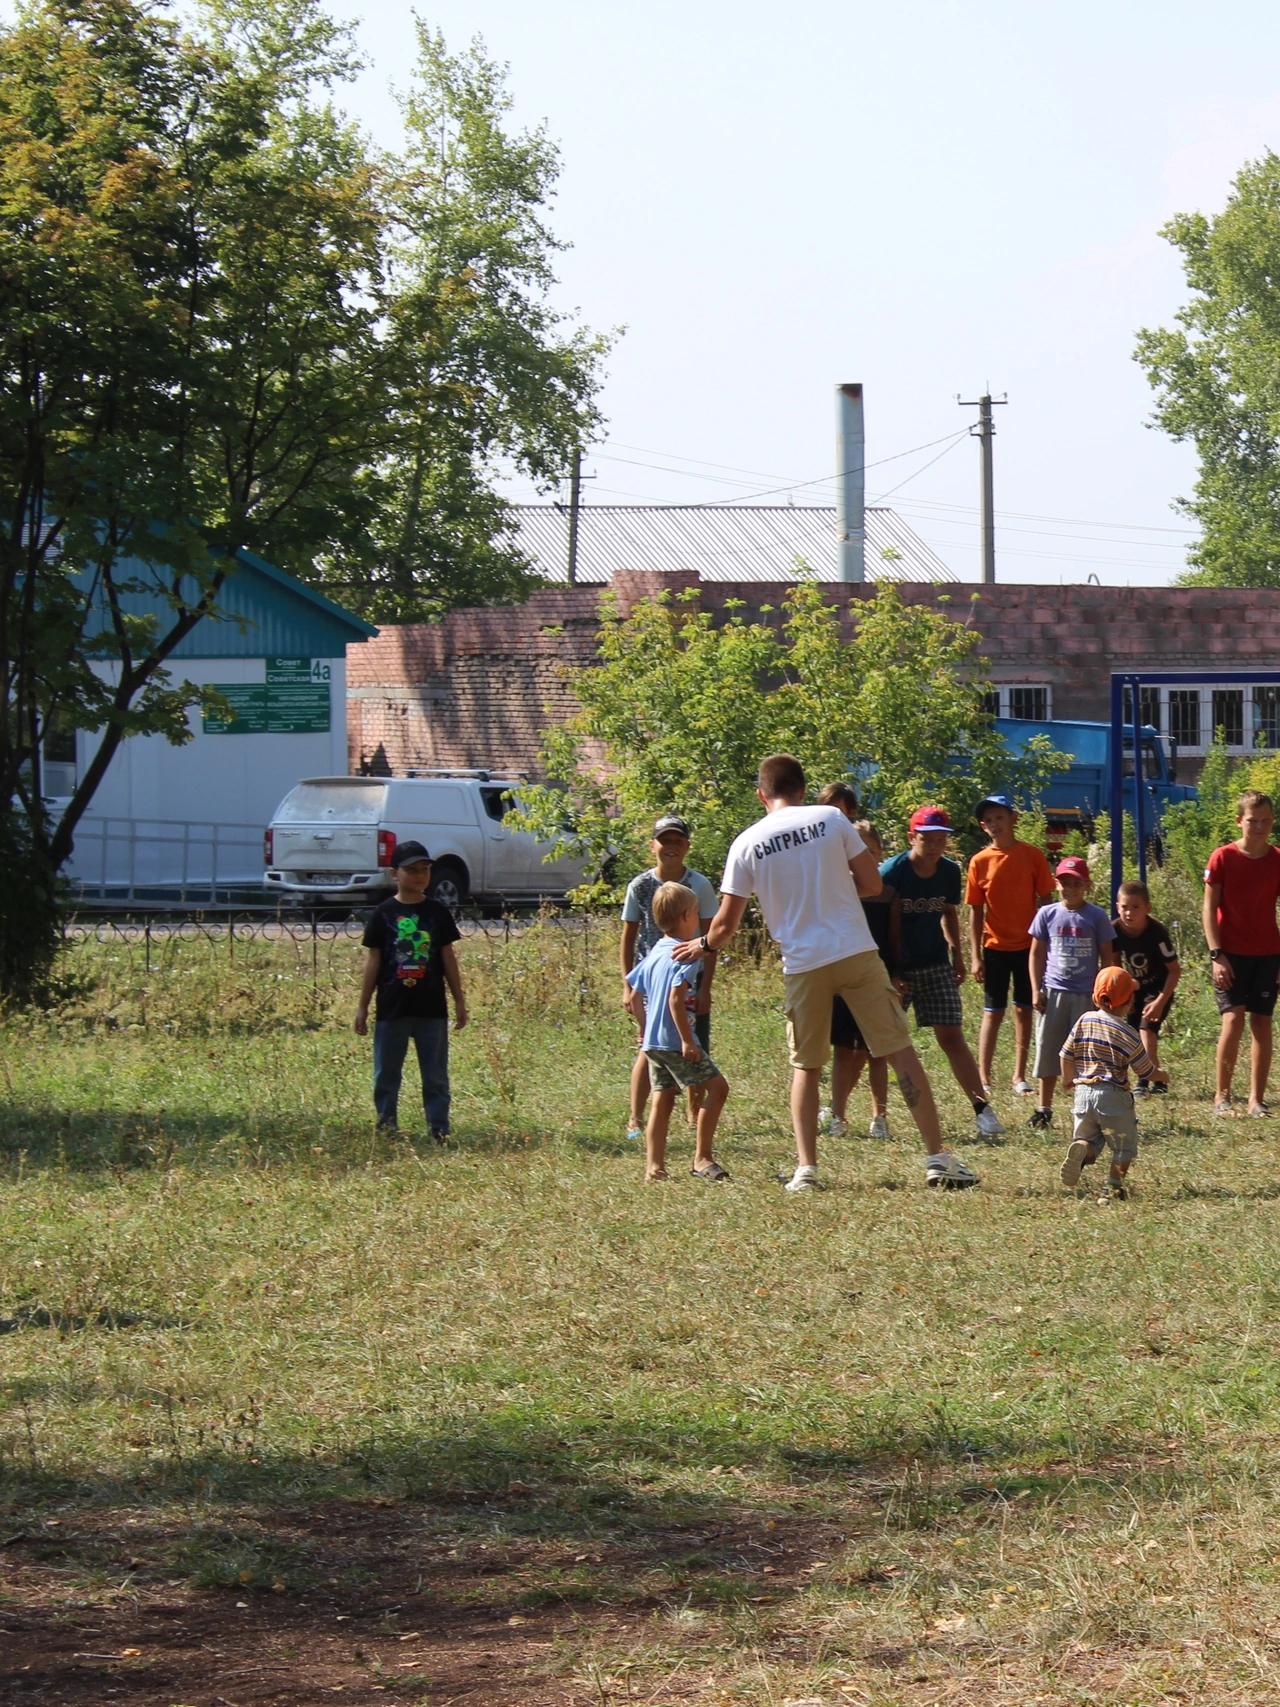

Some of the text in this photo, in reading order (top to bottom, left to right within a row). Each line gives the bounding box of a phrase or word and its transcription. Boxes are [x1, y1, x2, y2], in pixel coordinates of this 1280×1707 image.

[267, 674, 311, 682] Советская
[312, 660, 330, 680] 4а
[754, 822, 826, 860] СЫГРАЕМ?
[901, 896, 946, 913] BOSS
